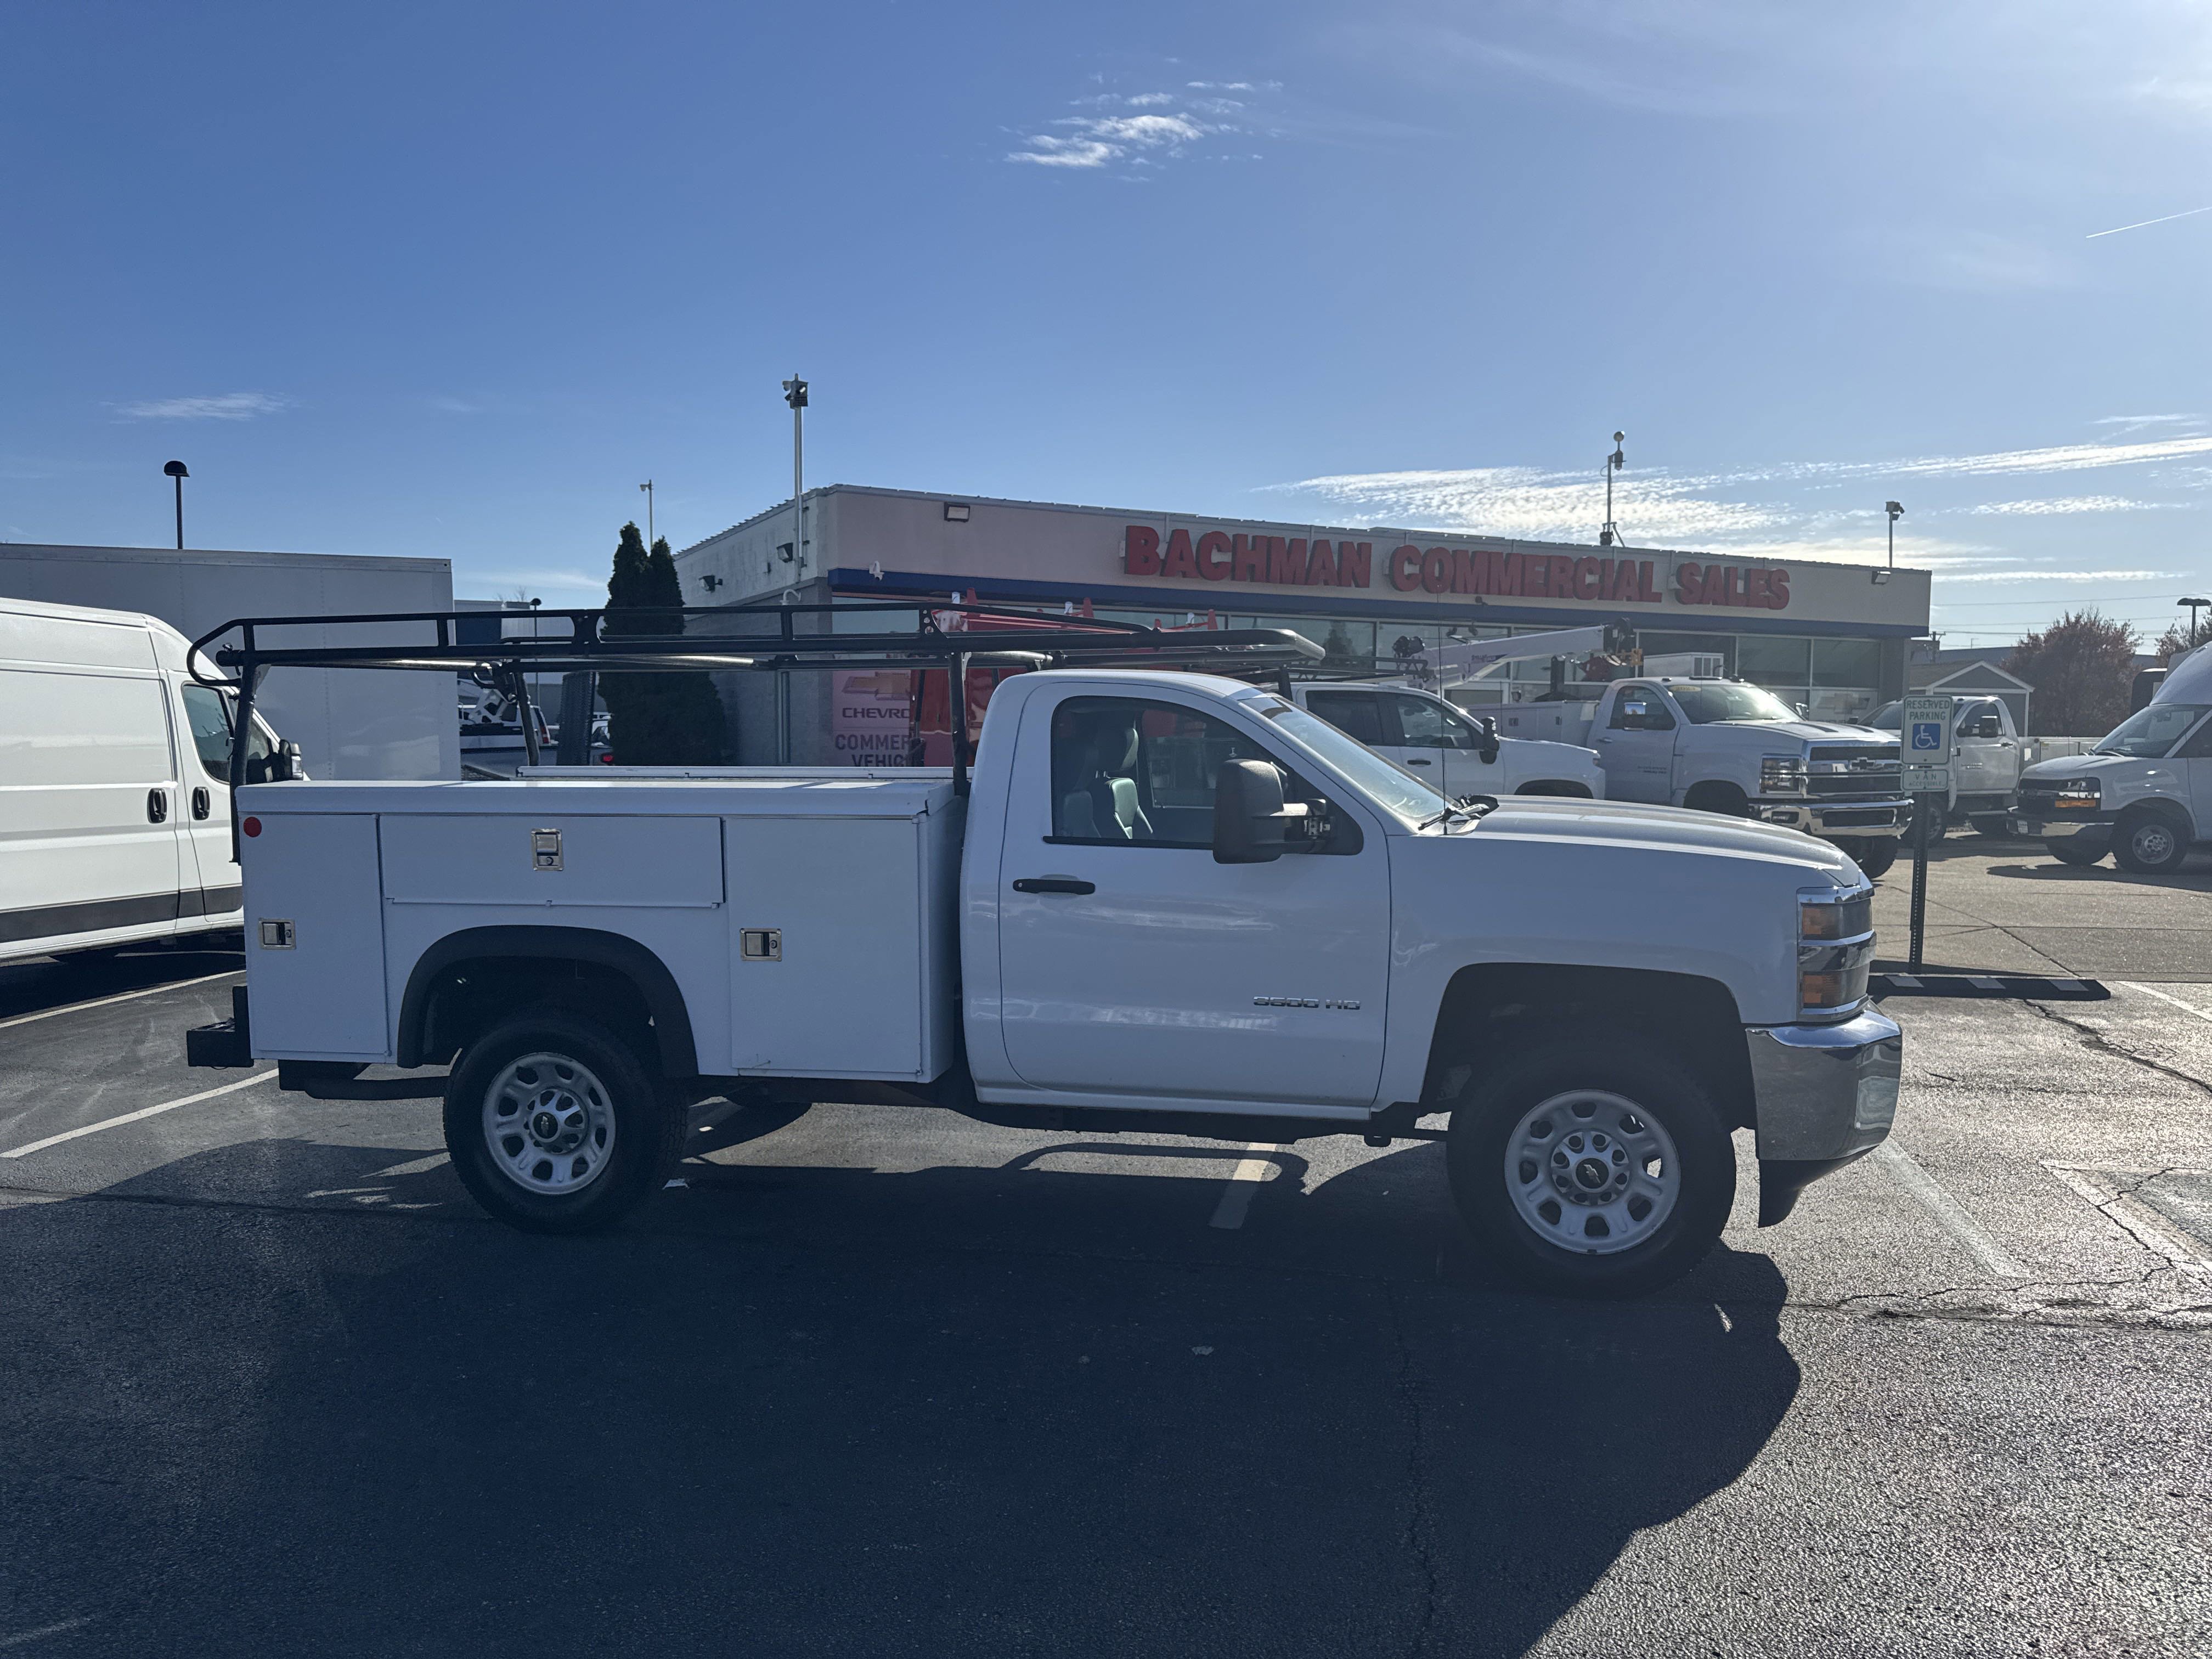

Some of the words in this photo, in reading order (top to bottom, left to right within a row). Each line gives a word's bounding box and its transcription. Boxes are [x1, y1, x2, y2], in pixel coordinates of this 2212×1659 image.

[1125, 526, 1372, 588] BACHMAN
[1390, 545, 1662, 602] COMMERCIAL
[1675, 562, 1790, 610] SALES
[1906, 700, 1950, 709] RESERVED
[1909, 712, 1946, 720] PARKING
